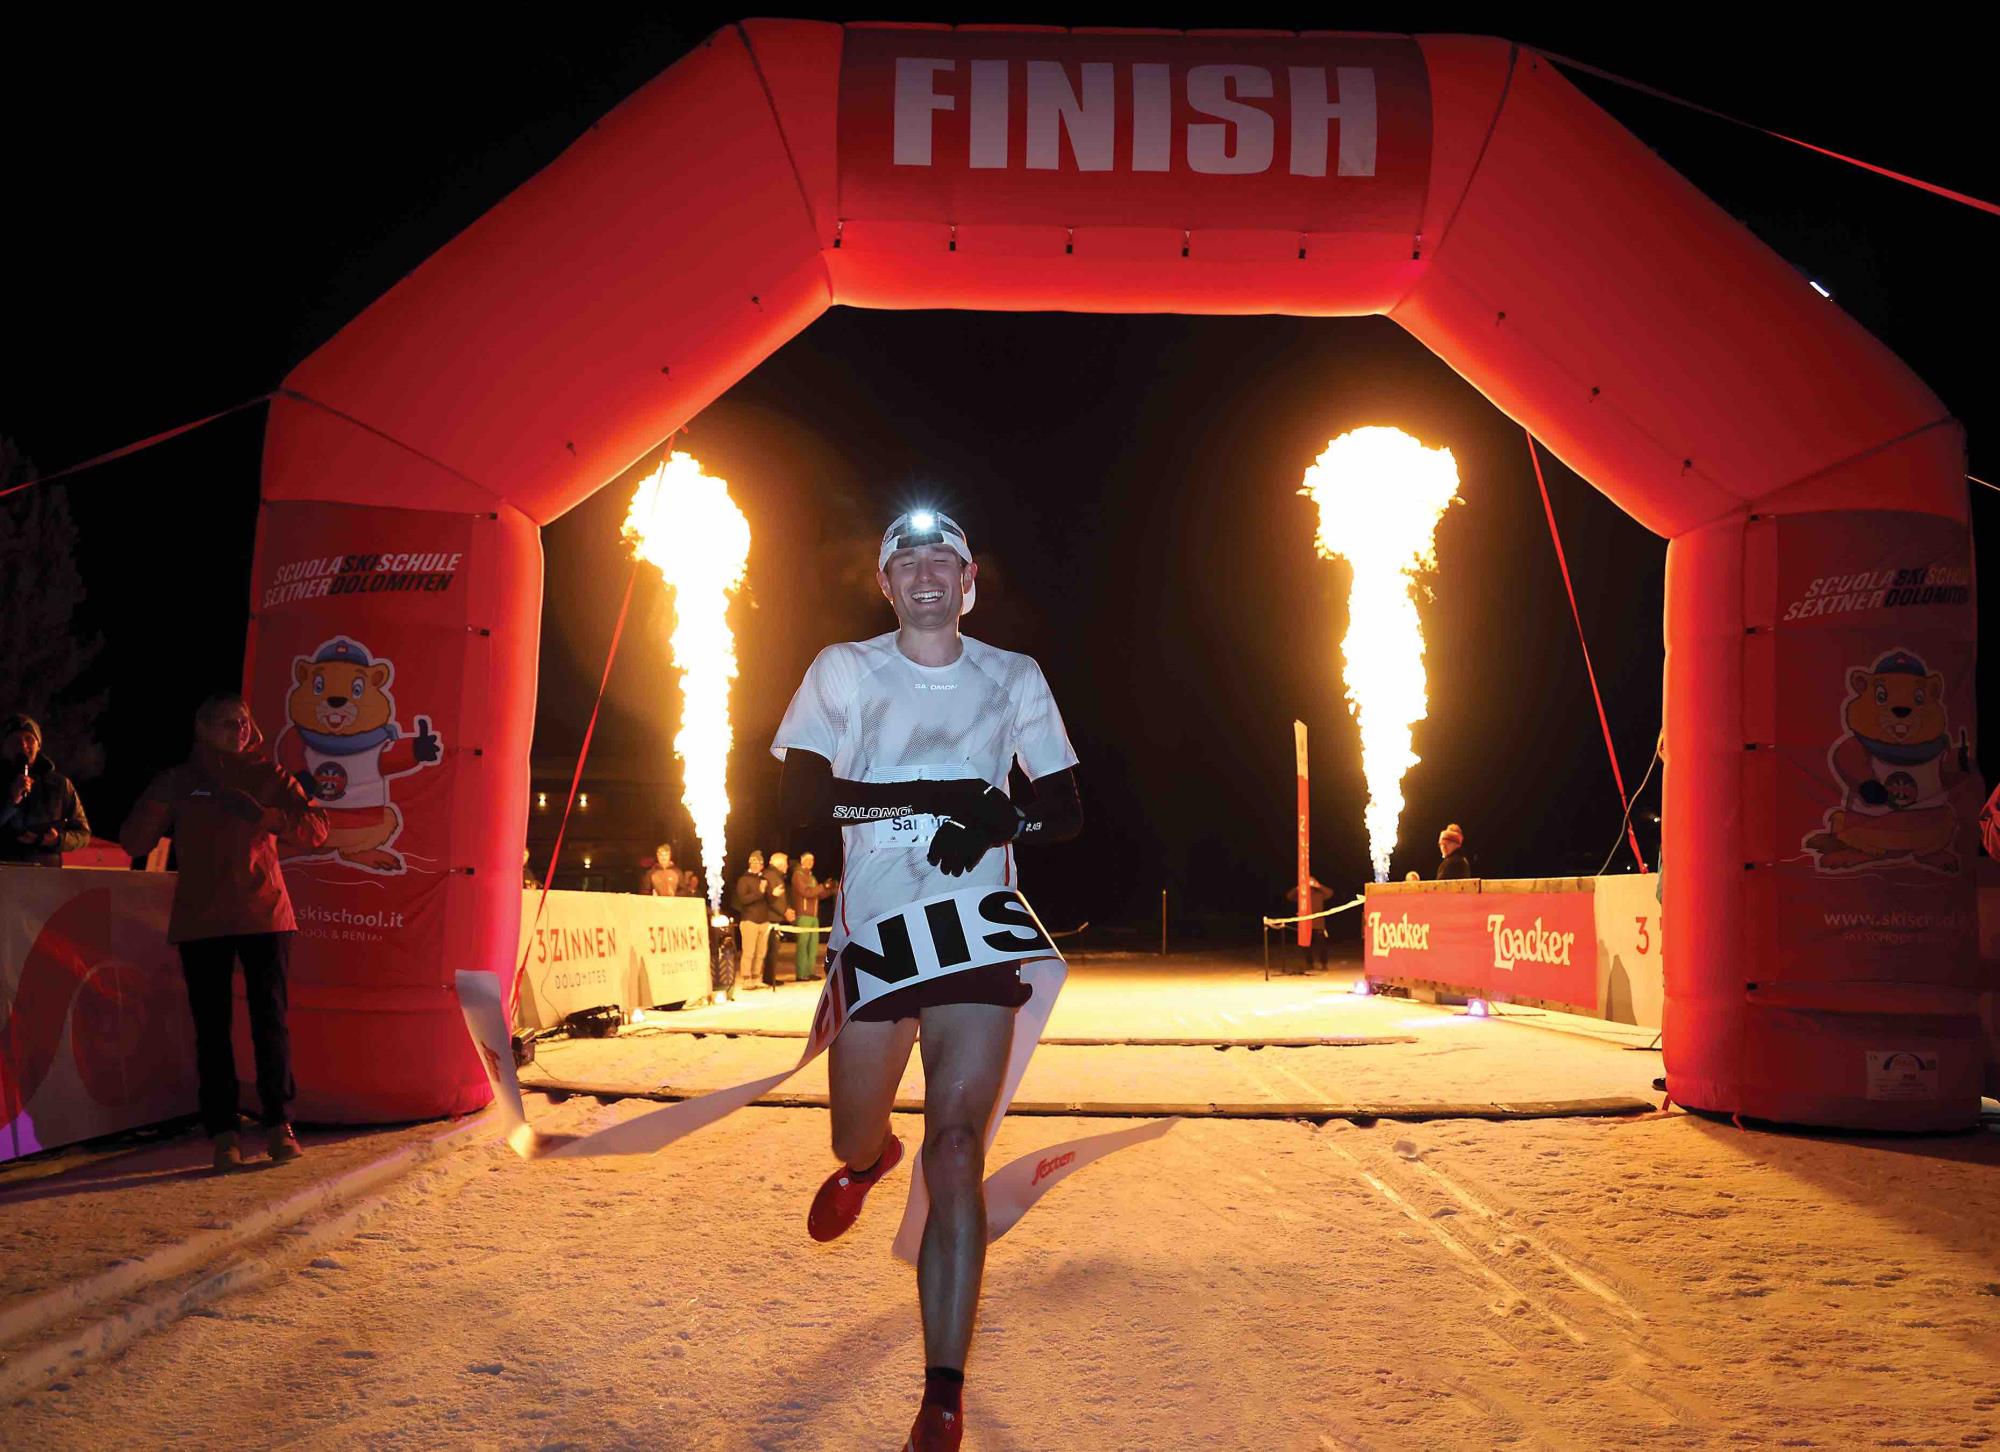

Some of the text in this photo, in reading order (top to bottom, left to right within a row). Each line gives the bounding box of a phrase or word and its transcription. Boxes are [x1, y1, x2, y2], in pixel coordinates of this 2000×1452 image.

[893, 57, 1378, 177] FINISH
[1368, 912, 1430, 957] Loacker
[1487, 914, 1575, 971] Loacker
